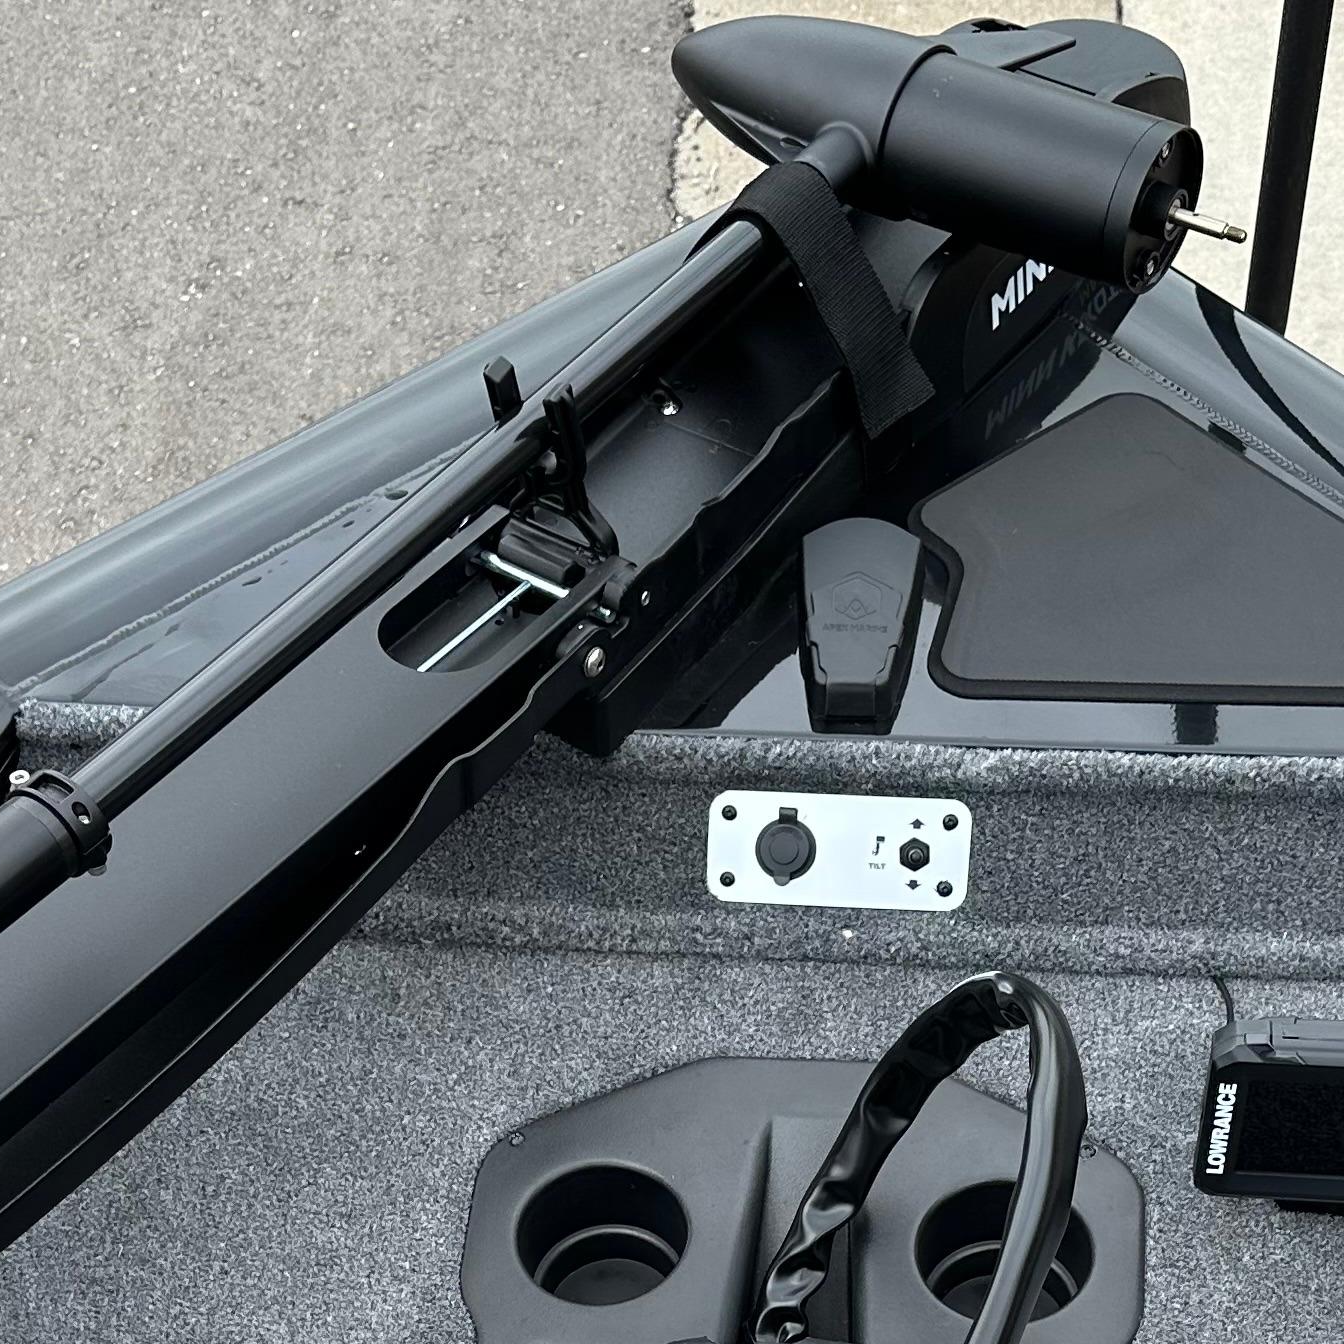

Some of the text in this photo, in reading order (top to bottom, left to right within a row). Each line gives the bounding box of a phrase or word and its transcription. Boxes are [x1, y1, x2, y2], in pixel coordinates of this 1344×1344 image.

[991, 259, 1055, 331] MIN
[822, 623, 848, 632] APEX
[868, 862, 886, 870] TILT
[1206, 1083, 1238, 1175] LOWRANCE
